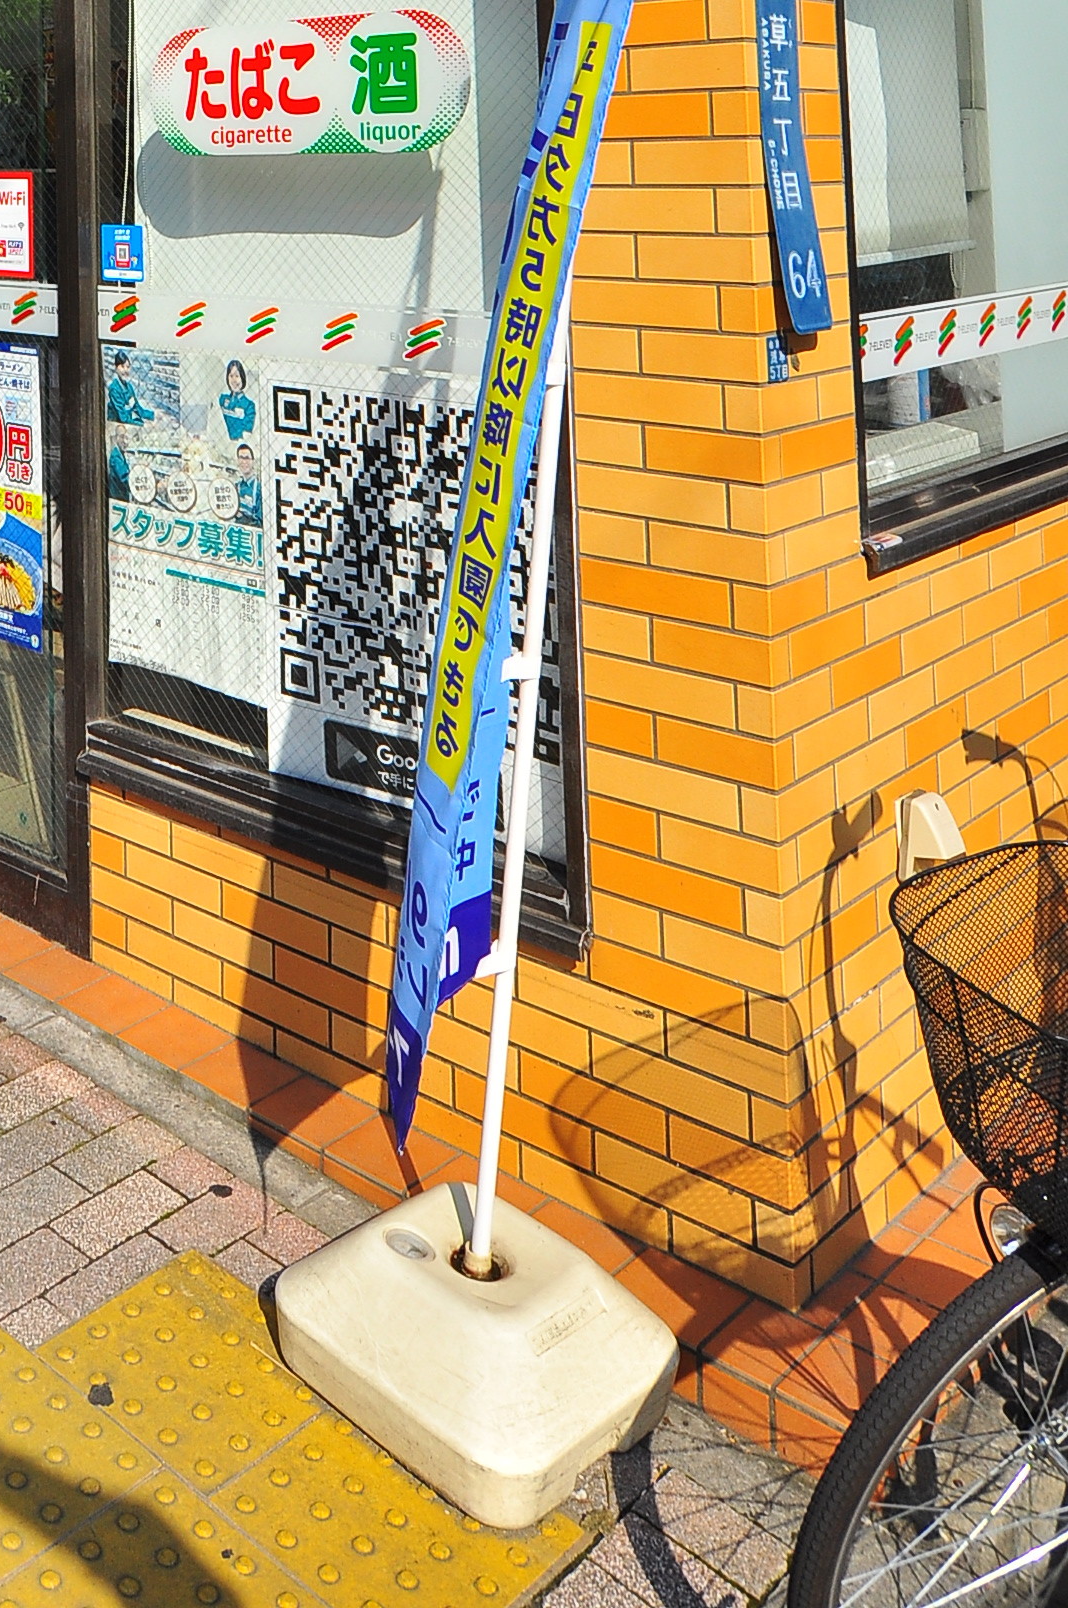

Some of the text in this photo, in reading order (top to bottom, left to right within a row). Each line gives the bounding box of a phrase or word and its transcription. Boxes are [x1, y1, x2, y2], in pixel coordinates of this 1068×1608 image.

[184, 39, 321, 122] たばこ
[350, 32, 418, 115] 酒
[210, 124, 293, 148] cigarette
[359, 122, 422, 145] liquor
[787, 249, 823, 300] 64
[0, 360, 24, 373] ラーメン
[6, 423, 33, 461] 円
[3, 490, 25, 513] 50
[111, 504, 263, 568] スタッフ募集!
[376, 745, 418, 771] Goo
